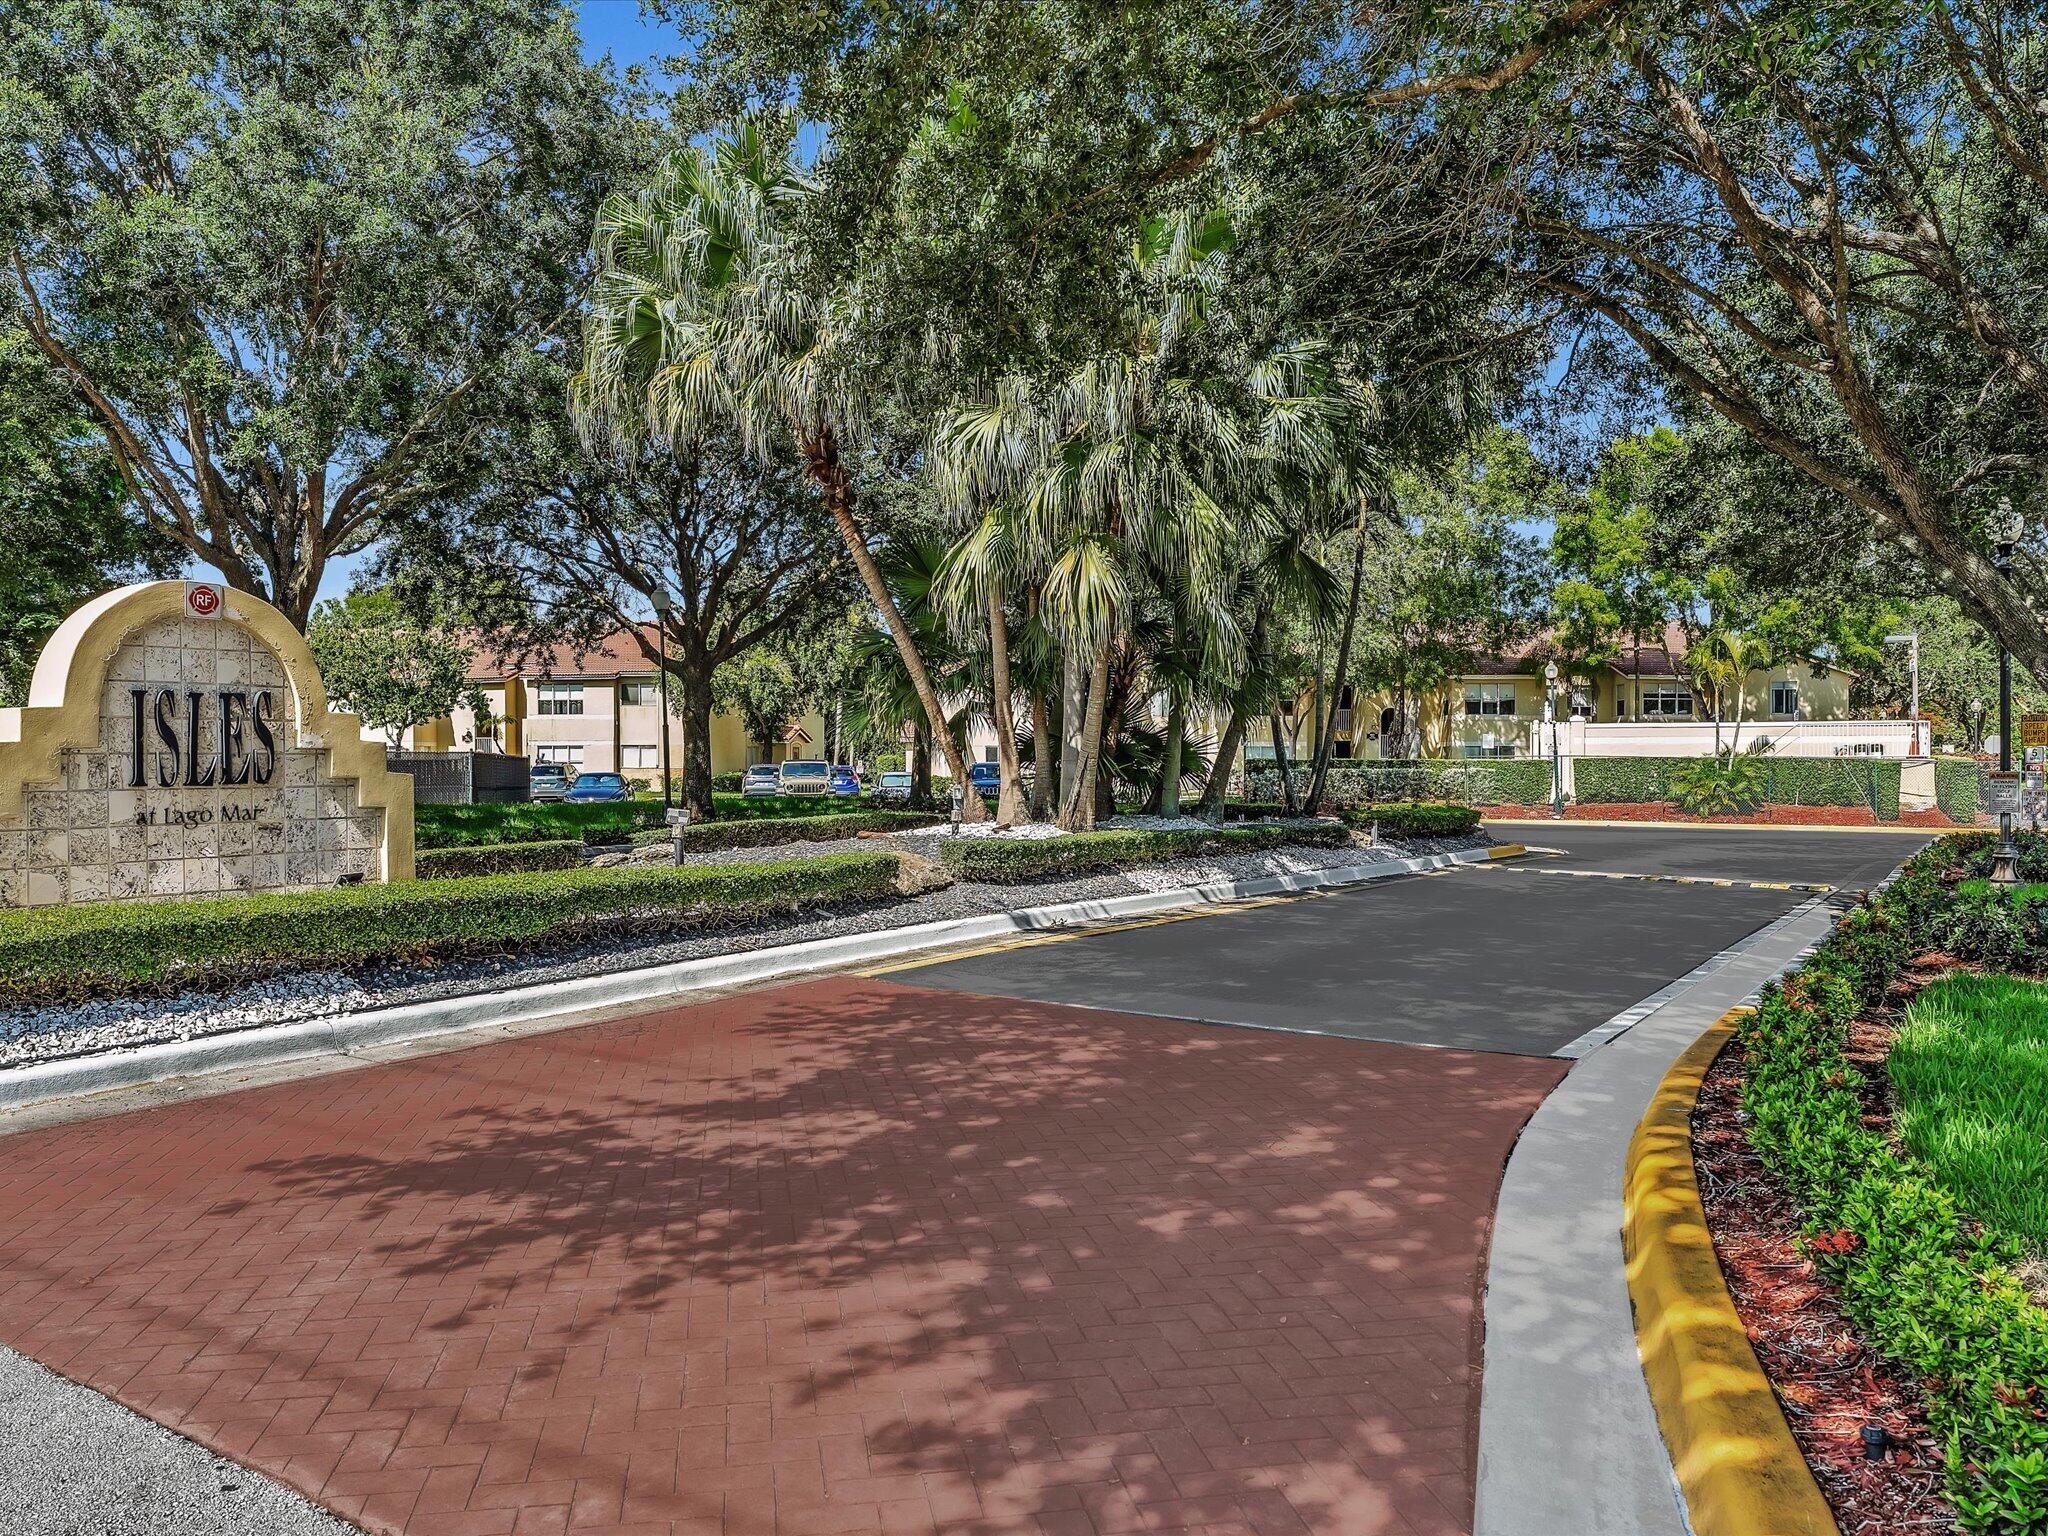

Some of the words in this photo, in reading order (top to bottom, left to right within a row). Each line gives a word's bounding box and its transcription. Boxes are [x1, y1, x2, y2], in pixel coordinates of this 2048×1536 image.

[196, 594, 212, 606] RF
[2024, 722, 2045, 730] SPEED
[127, 689, 275, 787] ISLES
[2032, 748, 2038, 757] 5
[136, 806, 156, 825] at
[164, 808, 213, 830] Lago
[220, 805, 265, 822] Mar
